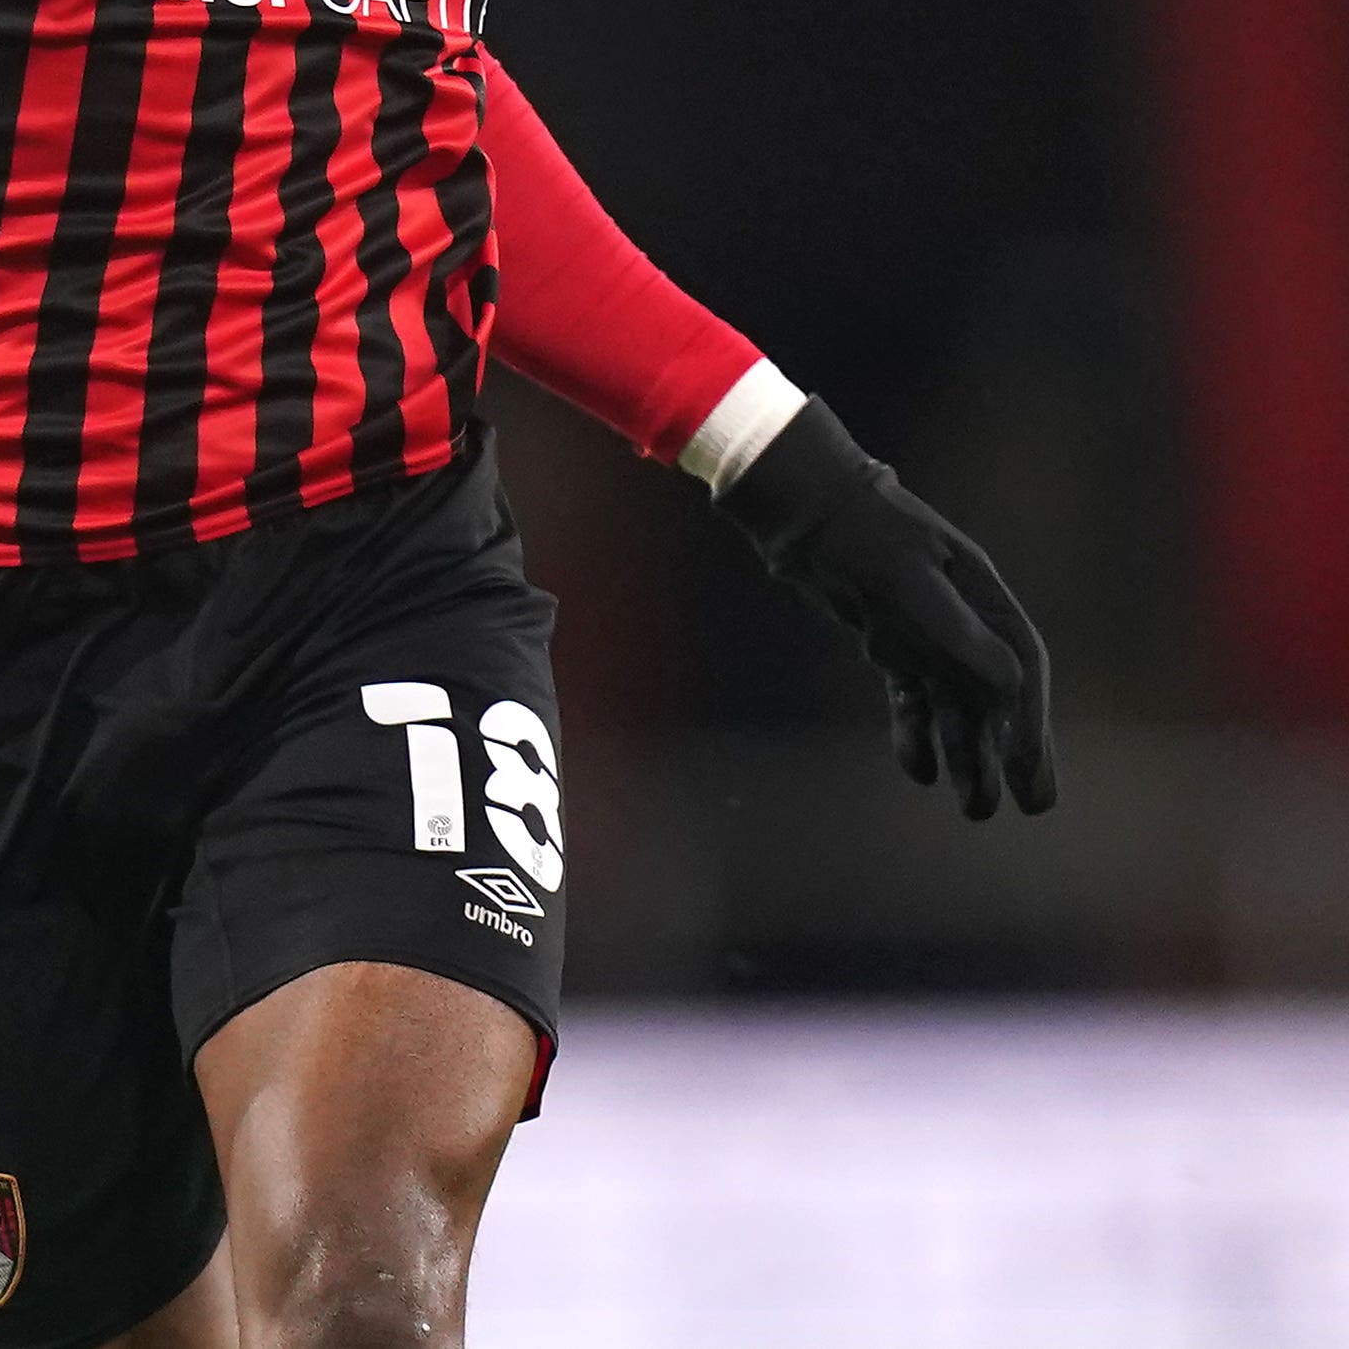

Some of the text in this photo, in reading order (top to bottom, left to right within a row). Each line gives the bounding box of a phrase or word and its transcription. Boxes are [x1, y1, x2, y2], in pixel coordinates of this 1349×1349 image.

[361, 681, 564, 893] 18
[430, 837, 451, 847] EFL
[463, 902, 533, 947] umbro
